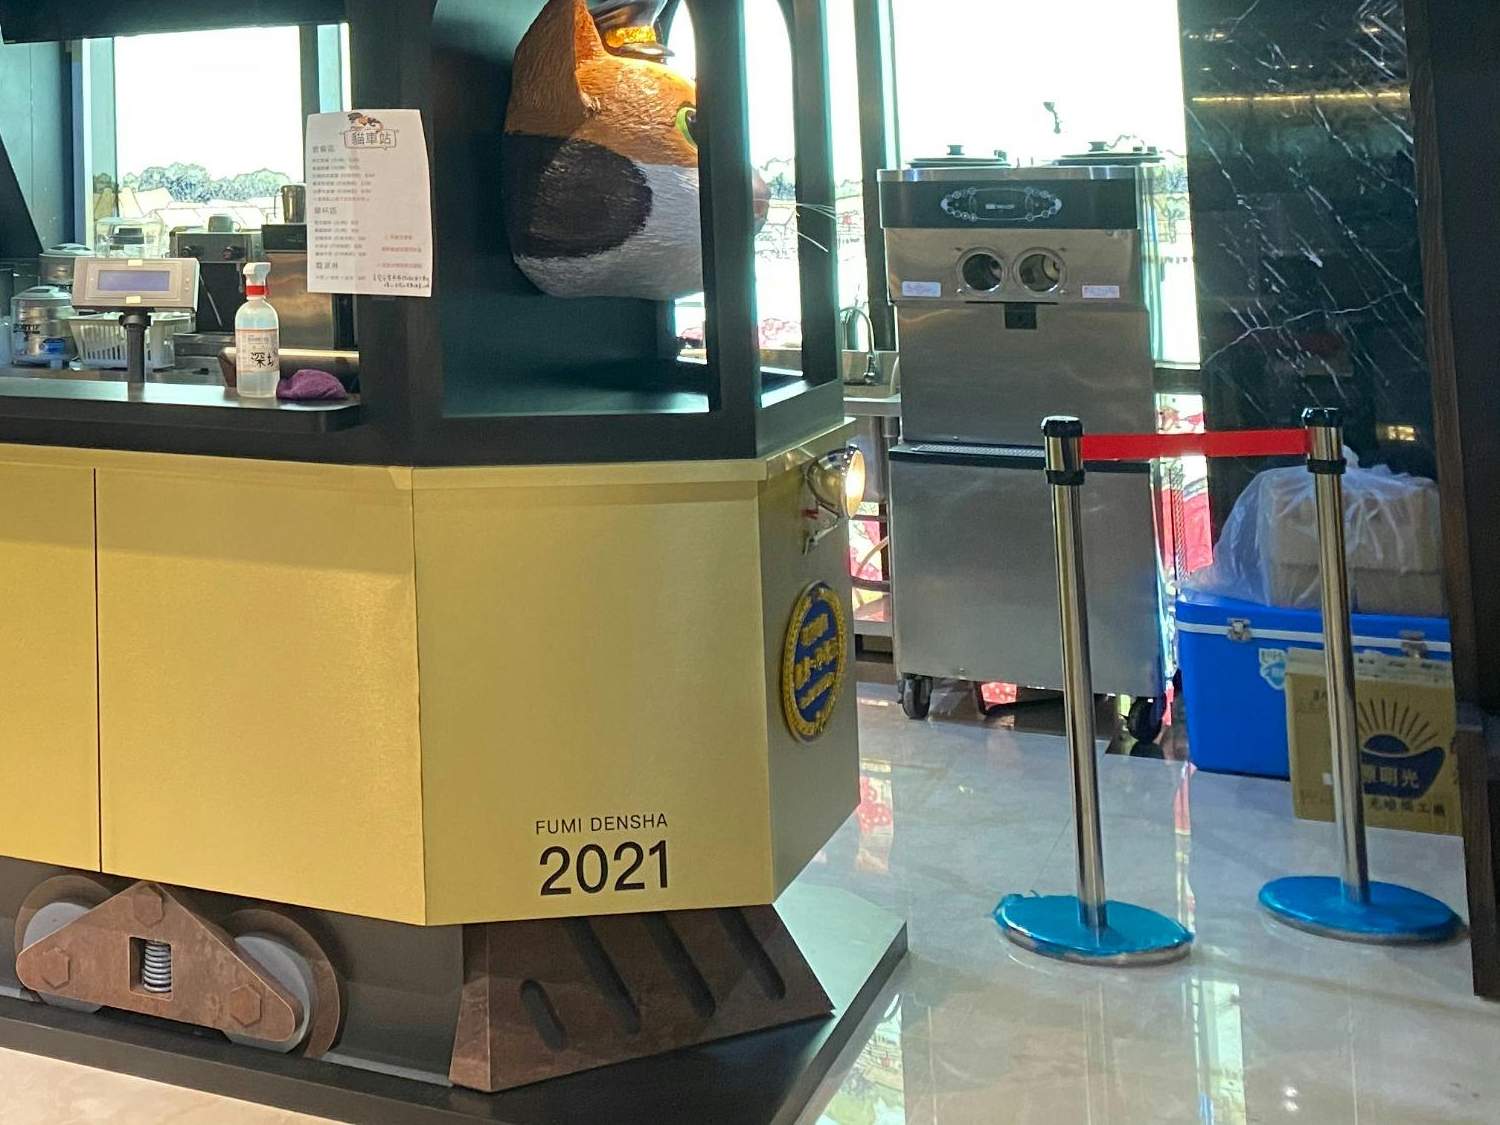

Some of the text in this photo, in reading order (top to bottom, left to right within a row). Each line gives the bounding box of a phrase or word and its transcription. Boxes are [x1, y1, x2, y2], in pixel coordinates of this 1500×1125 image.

[351, 130, 392, 146] 貓車站
[535, 812, 668, 836] FUMI DENSHA
[539, 839, 668, 896] 2021
